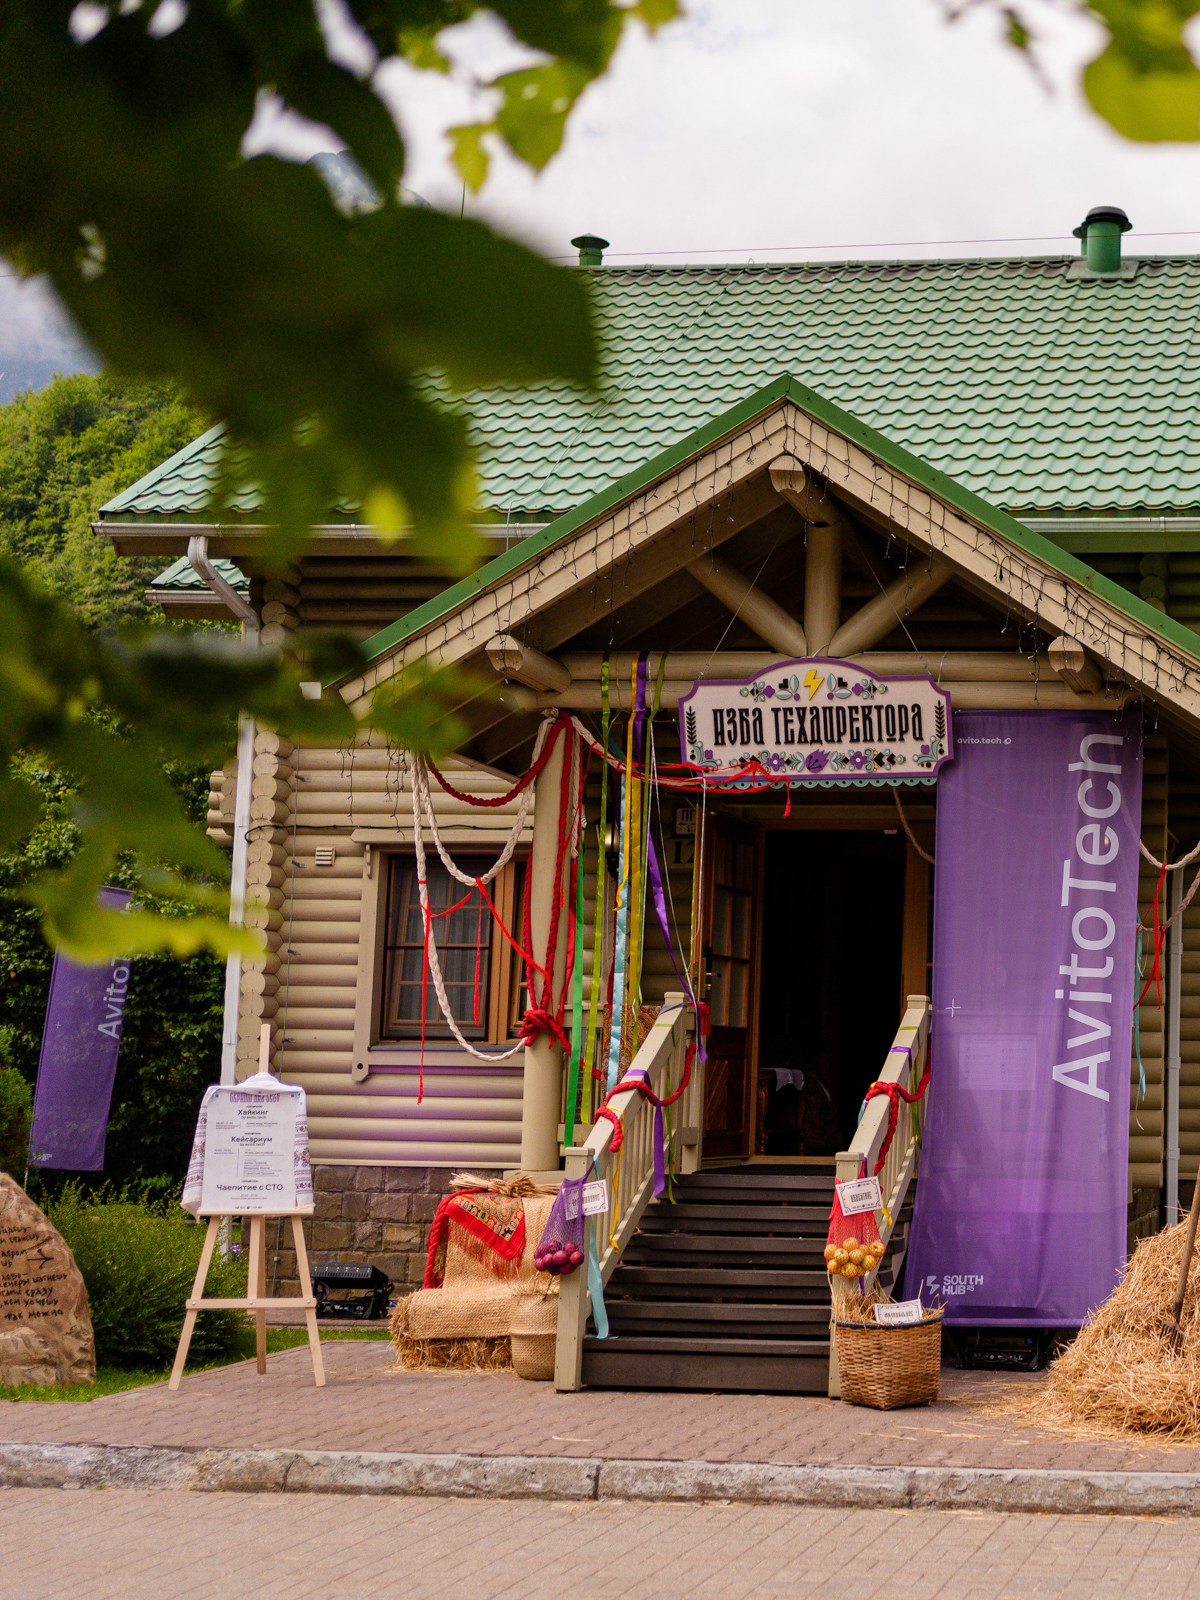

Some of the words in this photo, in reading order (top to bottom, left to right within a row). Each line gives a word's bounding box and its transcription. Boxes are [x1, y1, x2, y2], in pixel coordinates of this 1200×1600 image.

[712, 707, 765, 746] ИЗБА
[1052, 733, 1124, 1101] AvitoTech
[98, 948, 132, 1040] Avito
[231, 1136, 273, 1144] Кейсариум
[265, 1183, 284, 1191] СТО
[943, 1275, 984, 1286] SOUTH
